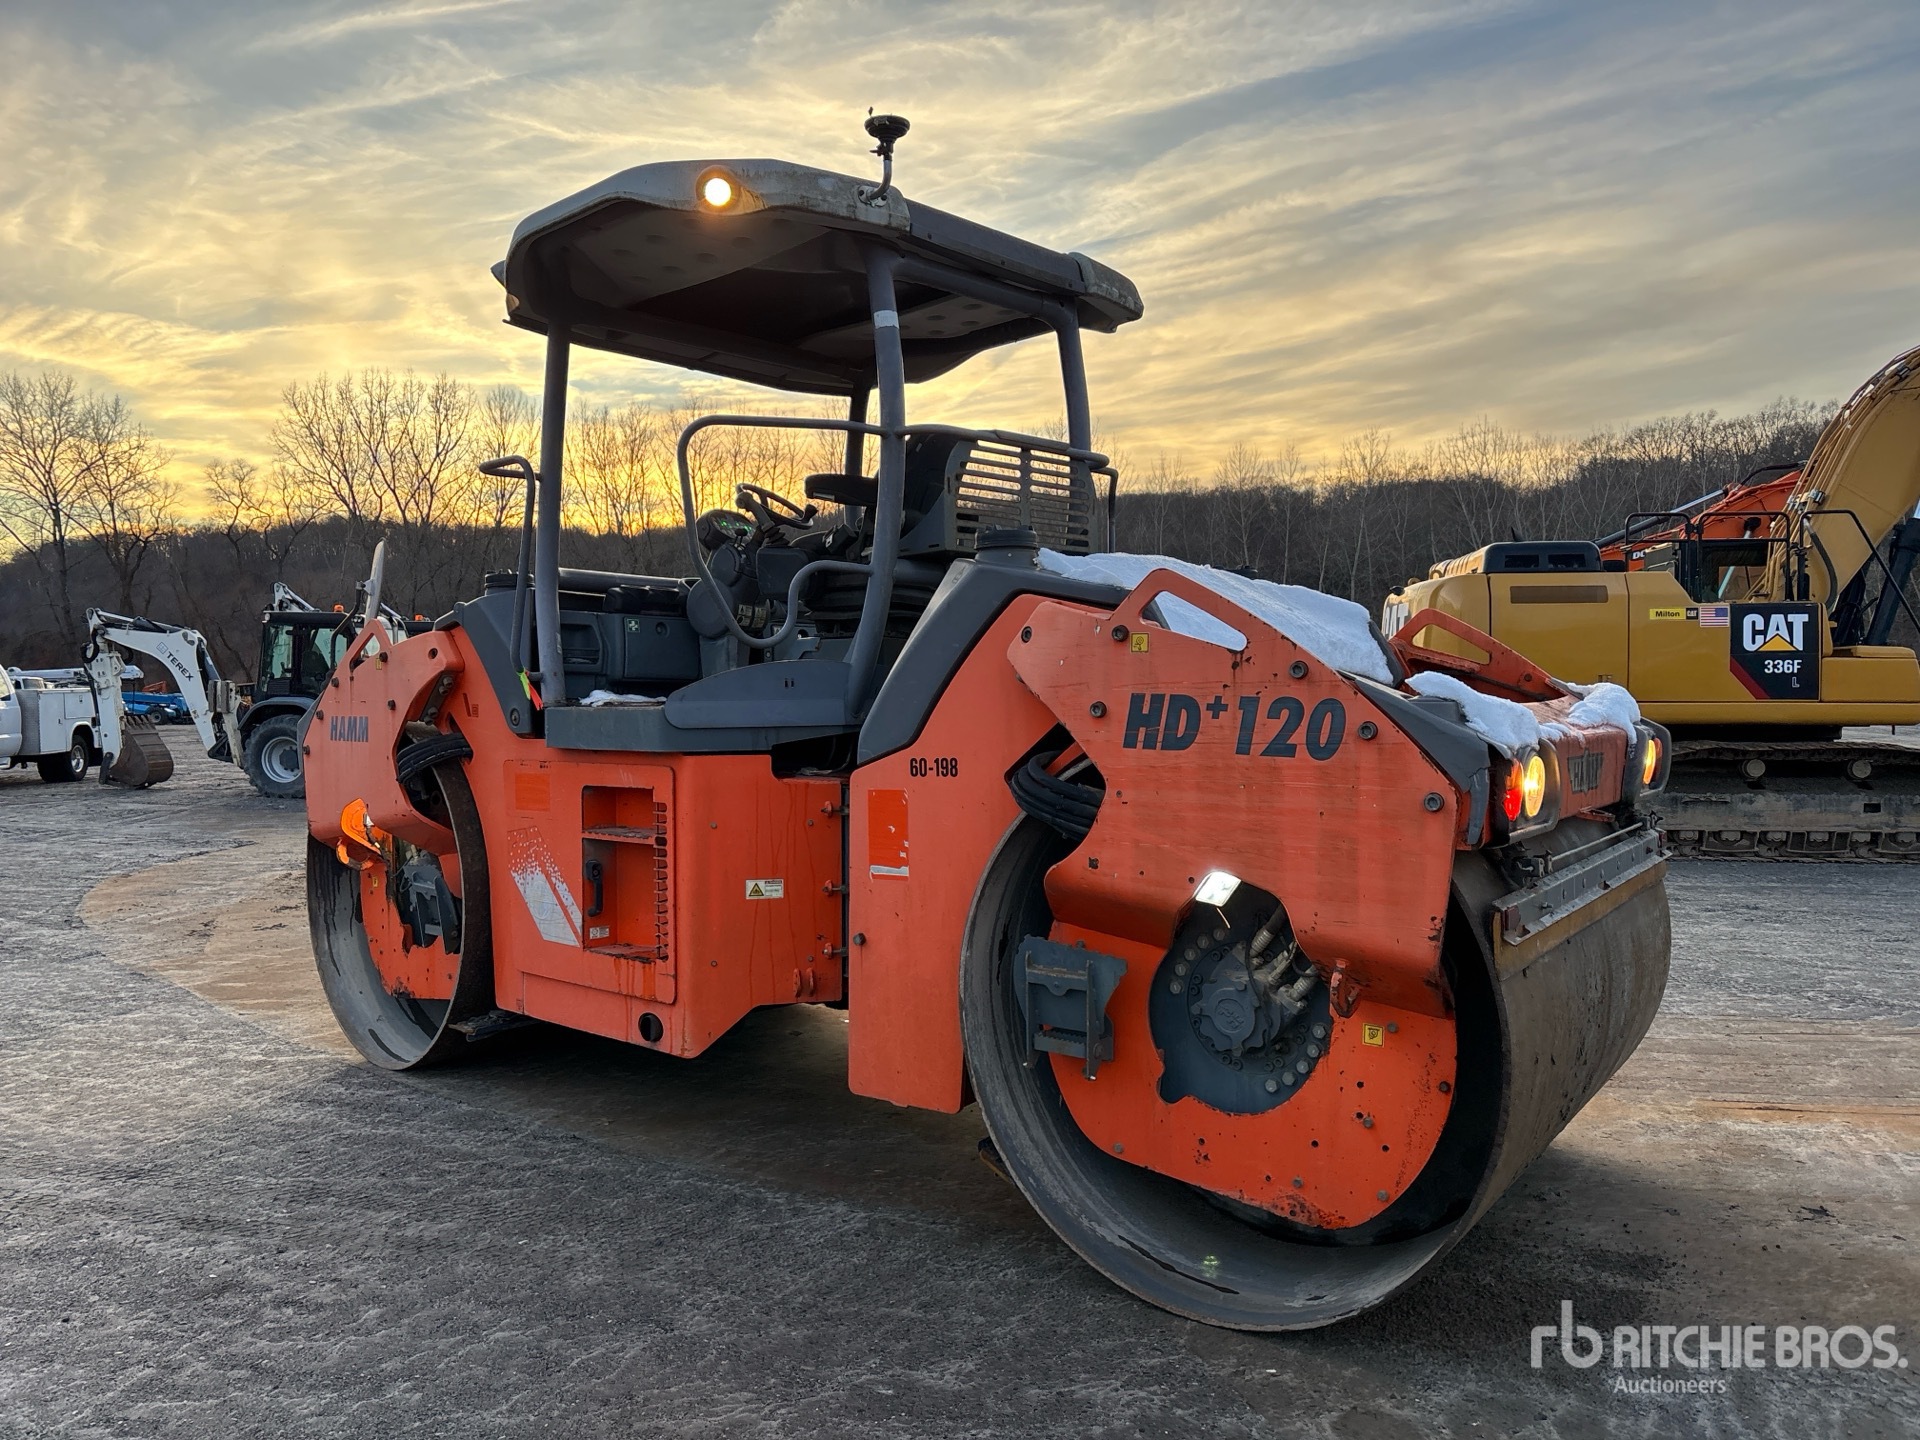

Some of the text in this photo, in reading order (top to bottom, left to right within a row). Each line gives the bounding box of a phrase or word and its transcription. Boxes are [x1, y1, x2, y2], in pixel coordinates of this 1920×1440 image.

[1655, 610, 1681, 618] Milton
[1743, 613, 1809, 652] CAT
[166, 651, 194, 682] TEREX
[1764, 659, 1802, 674] 336F
[1791, 676, 1800, 688] L
[330, 715, 369, 743] HAMM
[1234, 695, 1347, 761] 120
[910, 757, 959, 777] 60-198
